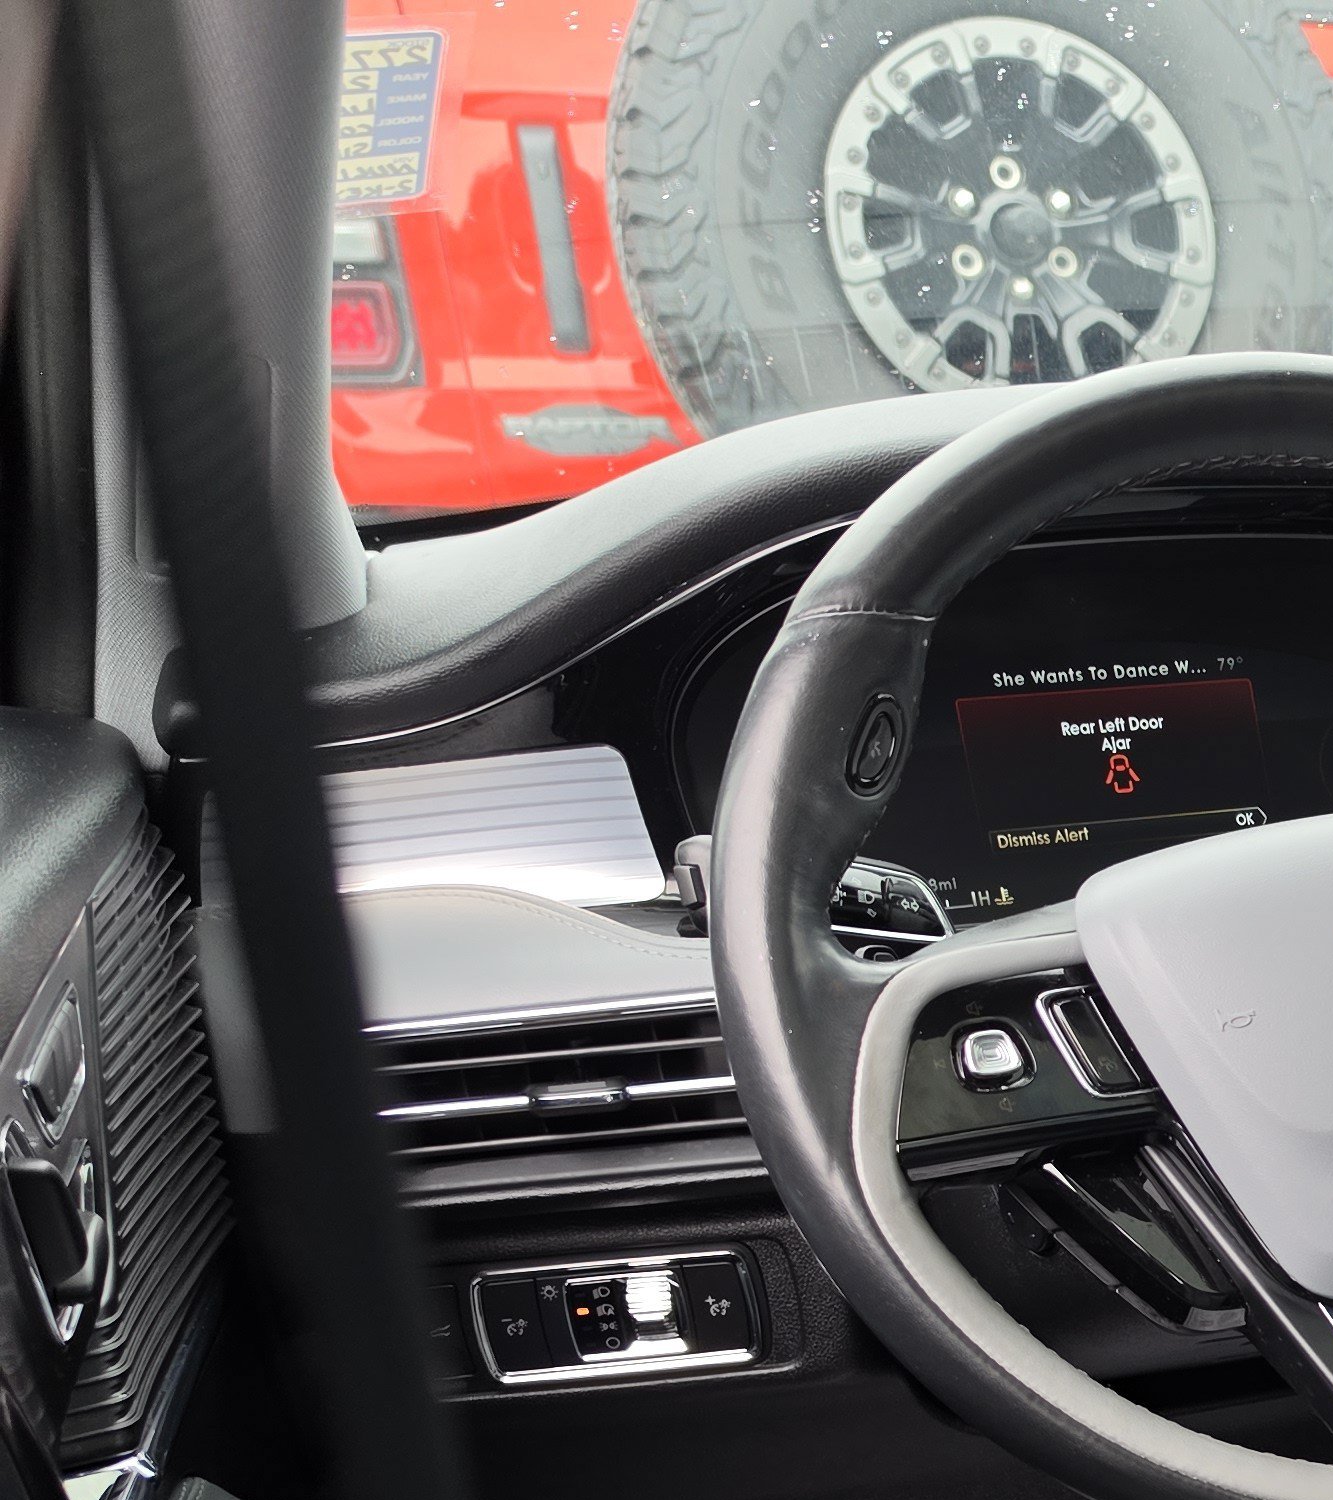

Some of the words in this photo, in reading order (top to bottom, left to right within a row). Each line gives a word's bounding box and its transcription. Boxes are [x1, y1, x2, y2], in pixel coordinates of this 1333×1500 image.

[993, 671, 1025, 688] She
[1030, 666, 1084, 684] Wants
[1087, 664, 1108, 681] To
[1113, 663, 1169, 680] Dance
[1060, 720, 1096, 737] Rear
[1098, 716, 1125, 734] Left
[1128, 715, 1164, 732] Door
[1101, 736, 1132, 754] Ajar
[1235, 810, 1256, 827] OK
[996, 830, 1051, 850] Dismiss
[1055, 826, 1089, 845] Alert
